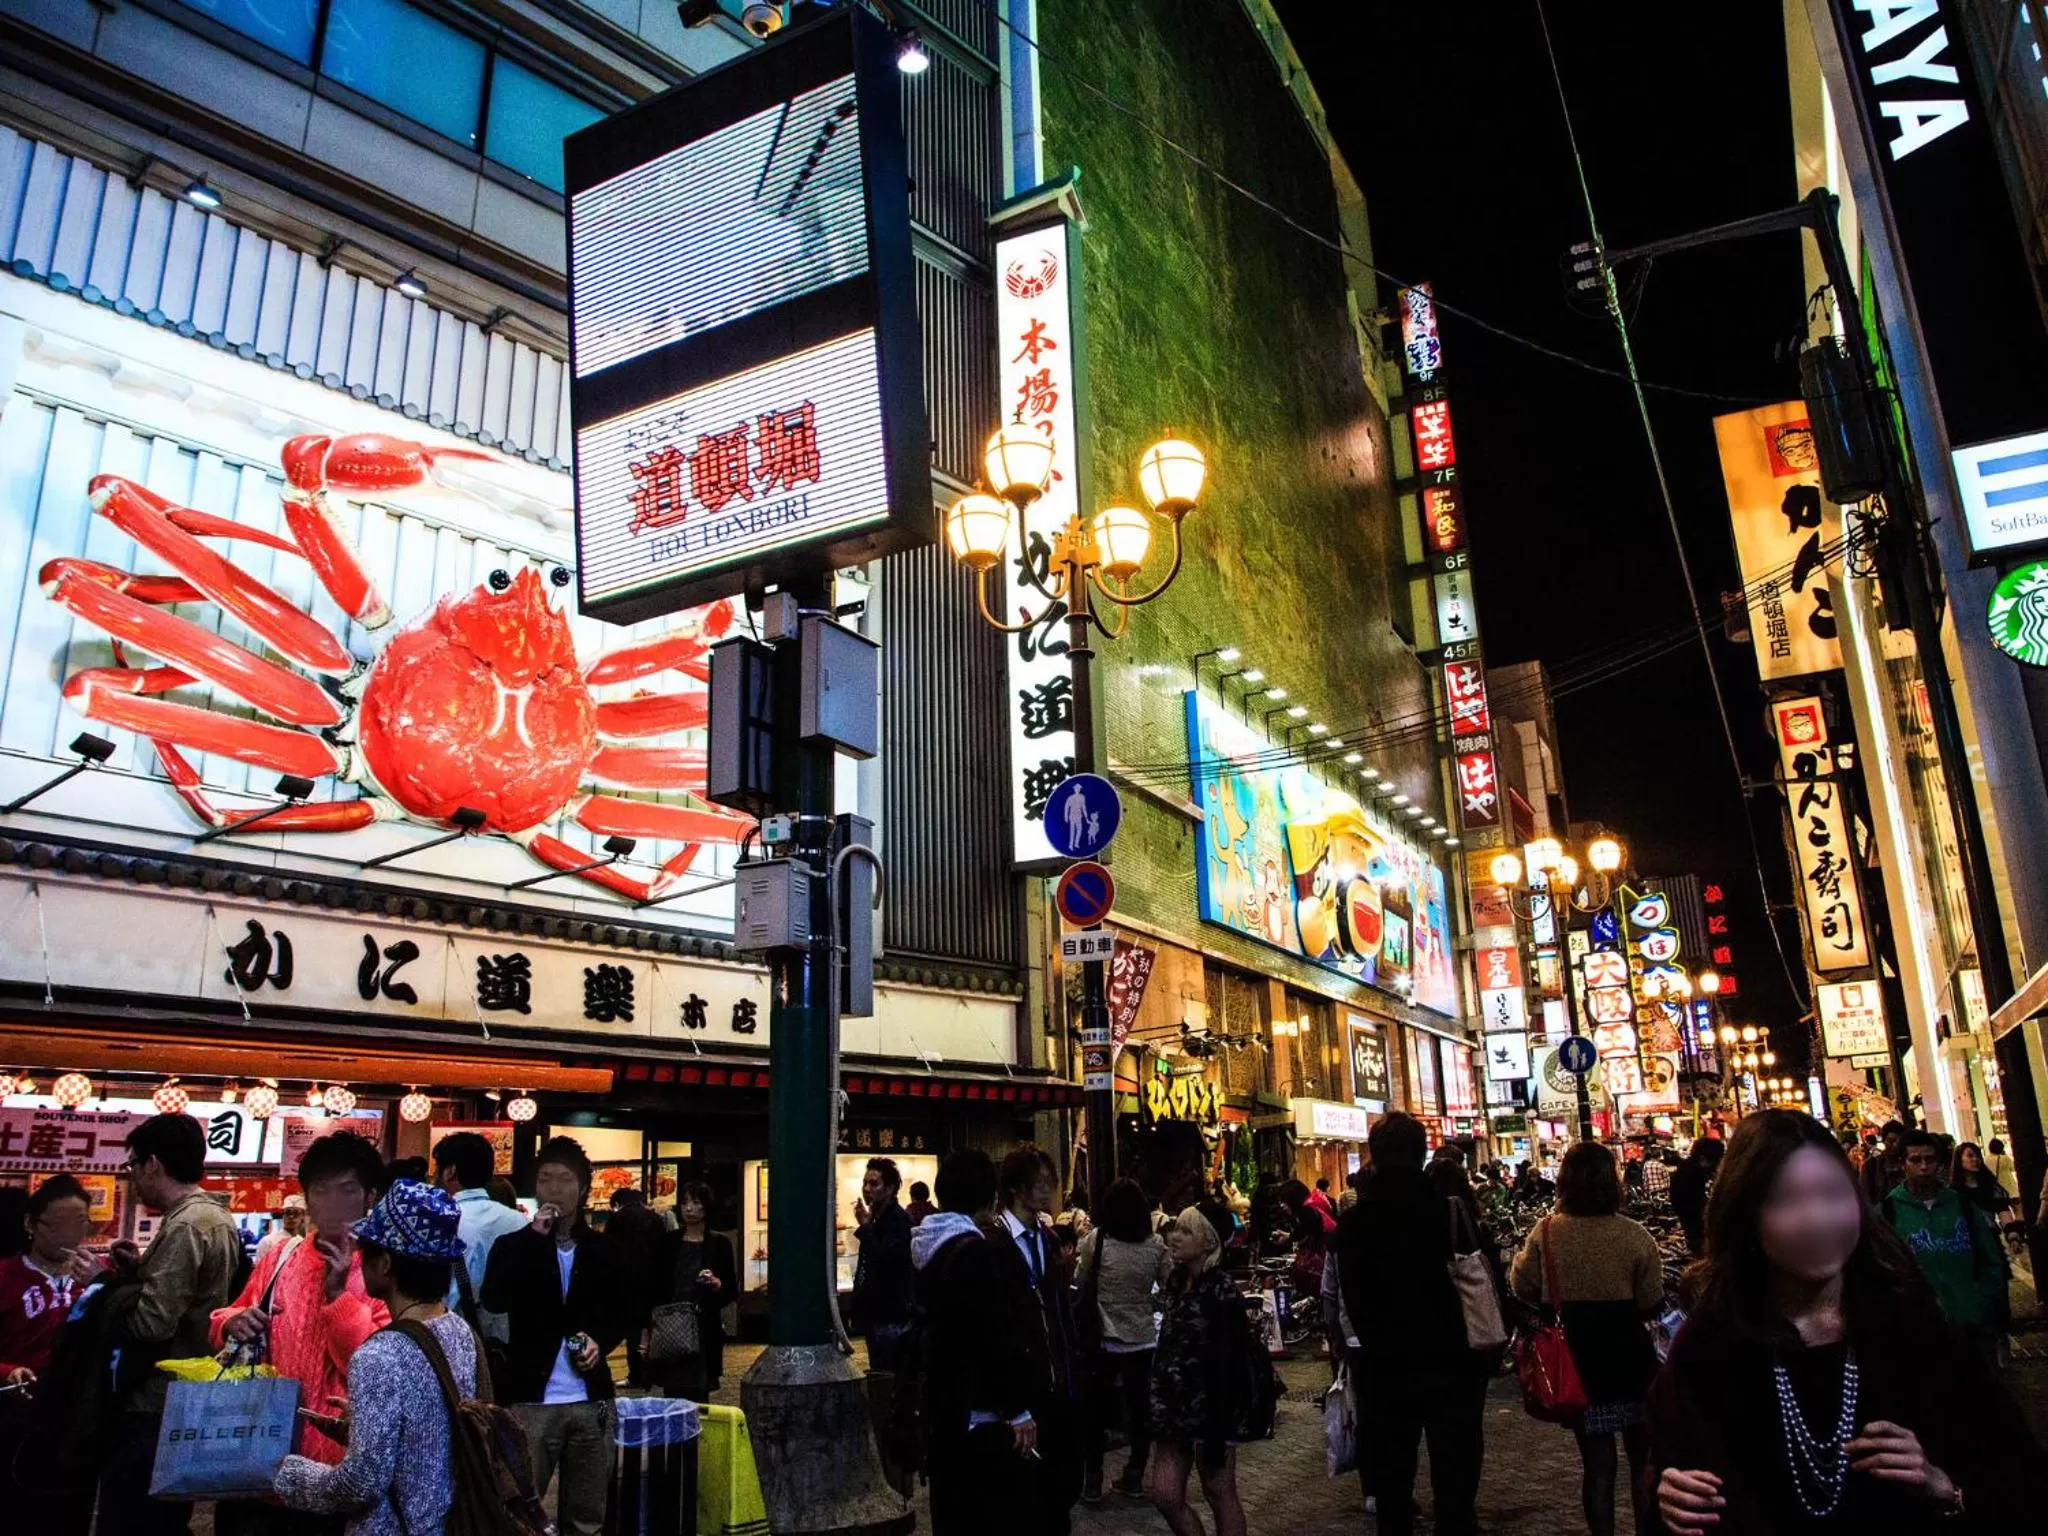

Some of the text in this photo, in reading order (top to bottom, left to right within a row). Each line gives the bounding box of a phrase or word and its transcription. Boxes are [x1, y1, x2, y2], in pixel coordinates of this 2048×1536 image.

[627, 399, 822, 536] 道頓堀
[1433, 467, 1456, 484] 7F
[1445, 553, 1468, 570] 6F
[1758, 583, 1792, 658] 道頓堀店
[1449, 665, 1483, 727] はや
[1456, 735, 1490, 753] 焼肉
[1459, 756, 1497, 821] はや
[1063, 936, 1112, 956] 自動車
[680, 993, 759, 1035] 本店
[1540, 1100, 1570, 1111] CAFE
[34, 1110, 129, 1124] SOUVENIR SHOP
